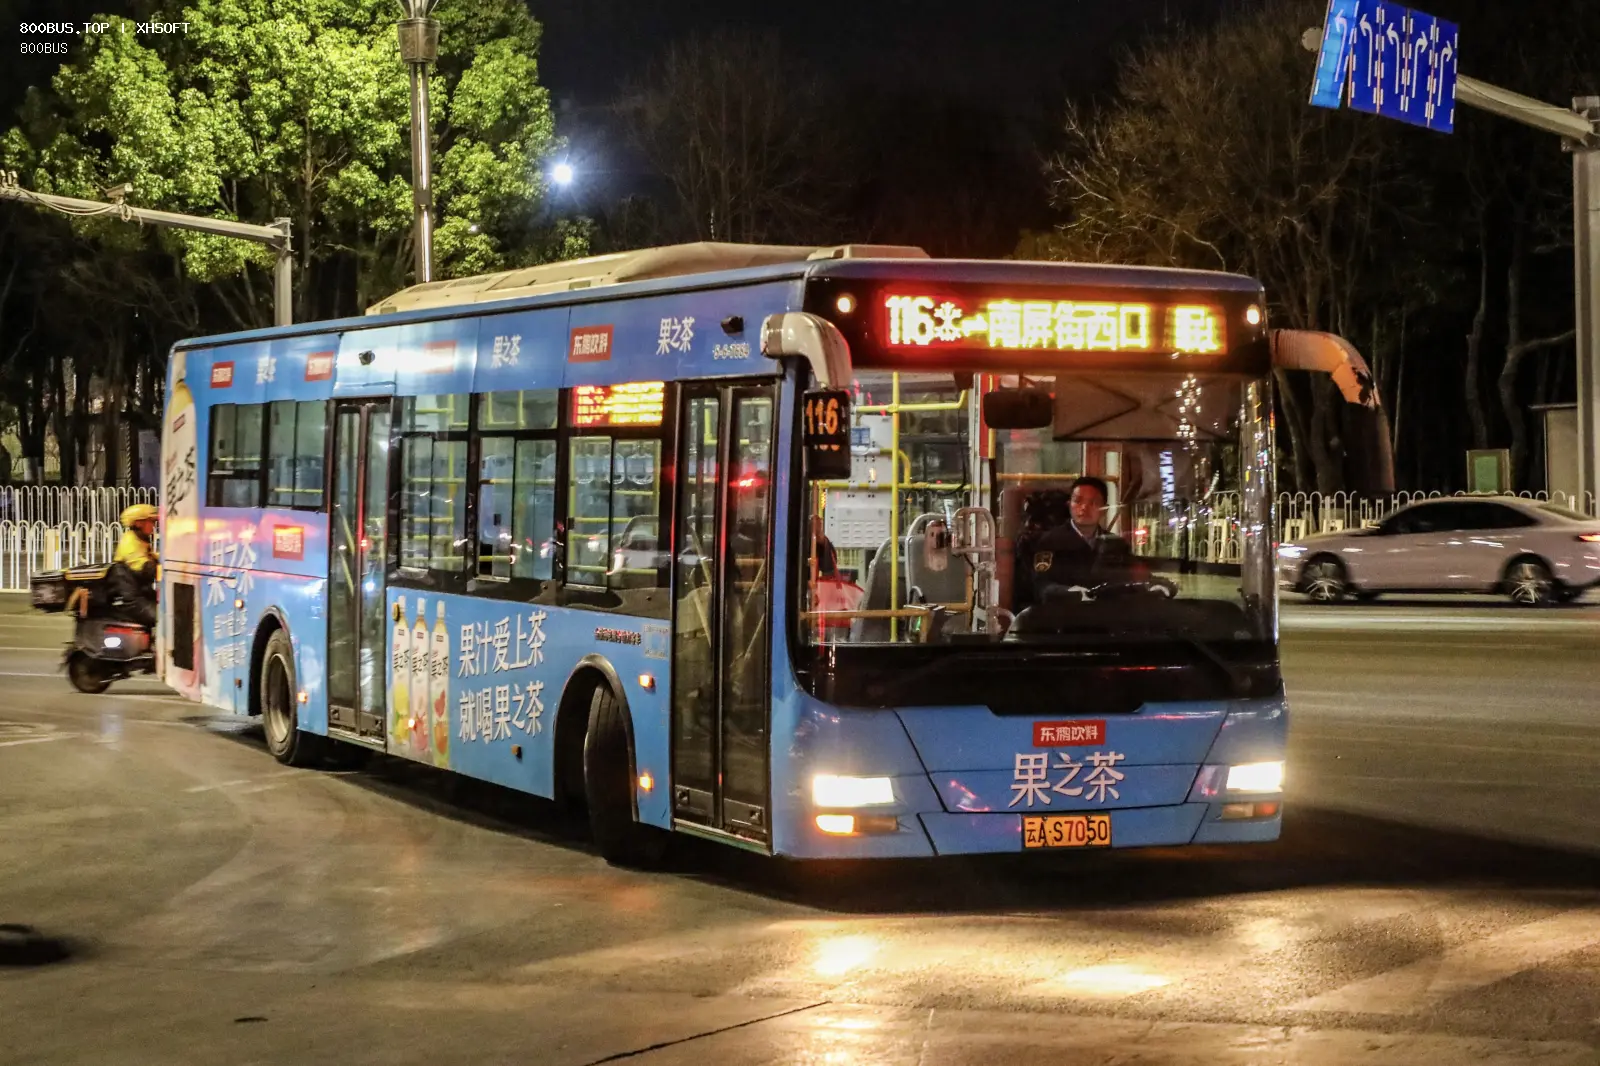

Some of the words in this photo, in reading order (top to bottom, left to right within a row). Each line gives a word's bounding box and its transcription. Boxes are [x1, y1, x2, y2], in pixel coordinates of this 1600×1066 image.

[656, 316, 695, 355] 果之茶
[885, 295, 935, 346] 116
[491, 334, 522, 369] 果之茶
[805, 398, 839, 436] 116
[458, 610, 547, 678] 果汁爱上茶
[458, 679, 544, 744] 就喝果之茶
[1040, 725, 1098, 742] 东鹏饮料
[1008, 751, 1125, 808] 果之茶
